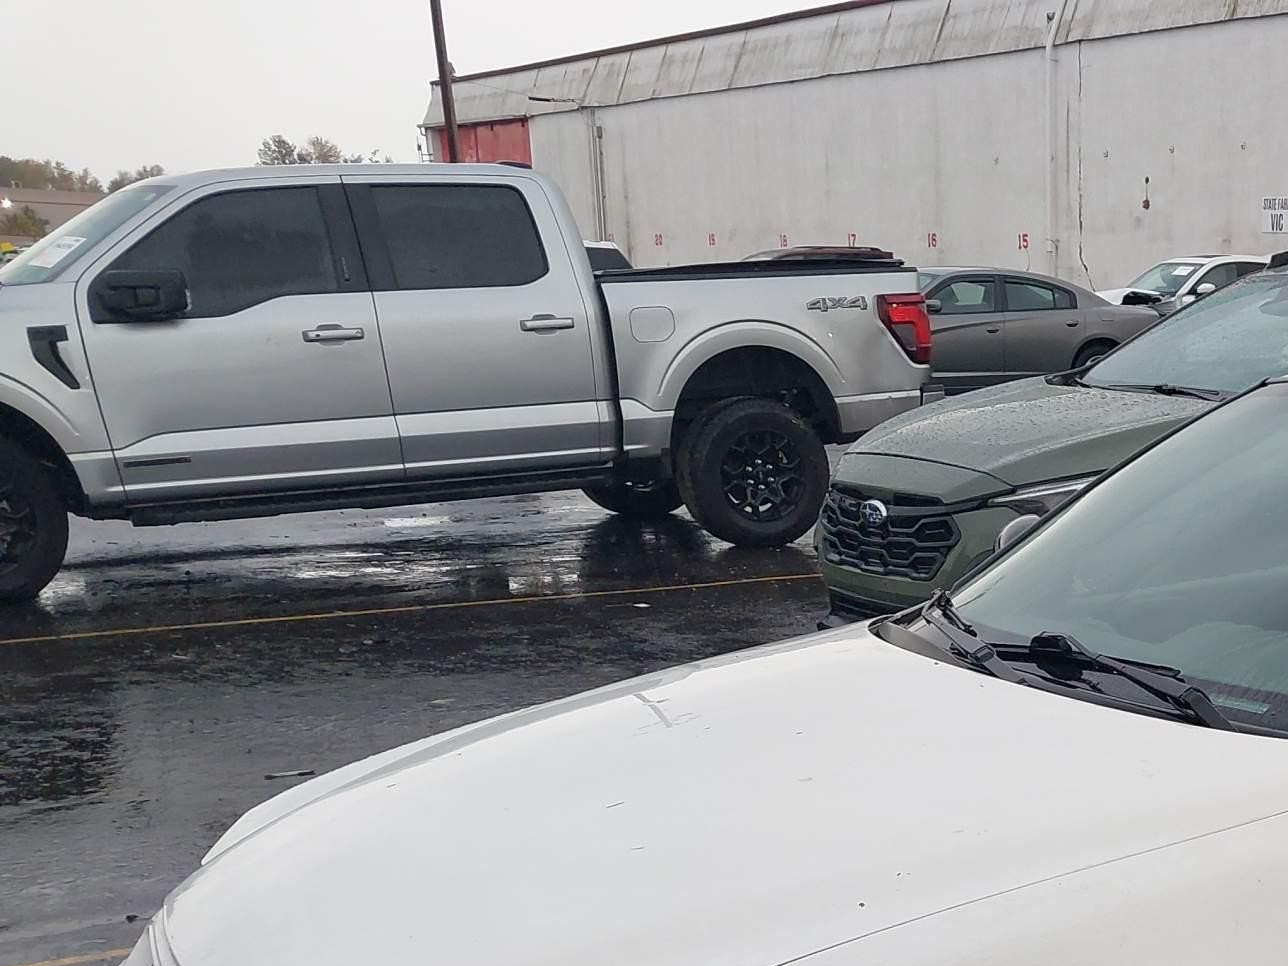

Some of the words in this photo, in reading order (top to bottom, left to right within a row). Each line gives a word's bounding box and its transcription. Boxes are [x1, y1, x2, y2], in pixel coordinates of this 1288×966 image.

[1263, 198, 1277, 210] STATE
[1270, 213, 1284, 231] VIC
[654, 233, 663, 246] 20
[708, 233, 716, 246] 19
[847, 233, 857, 247] 17
[927, 233, 937, 248] 16
[1018, 233, 1029, 249] 15
